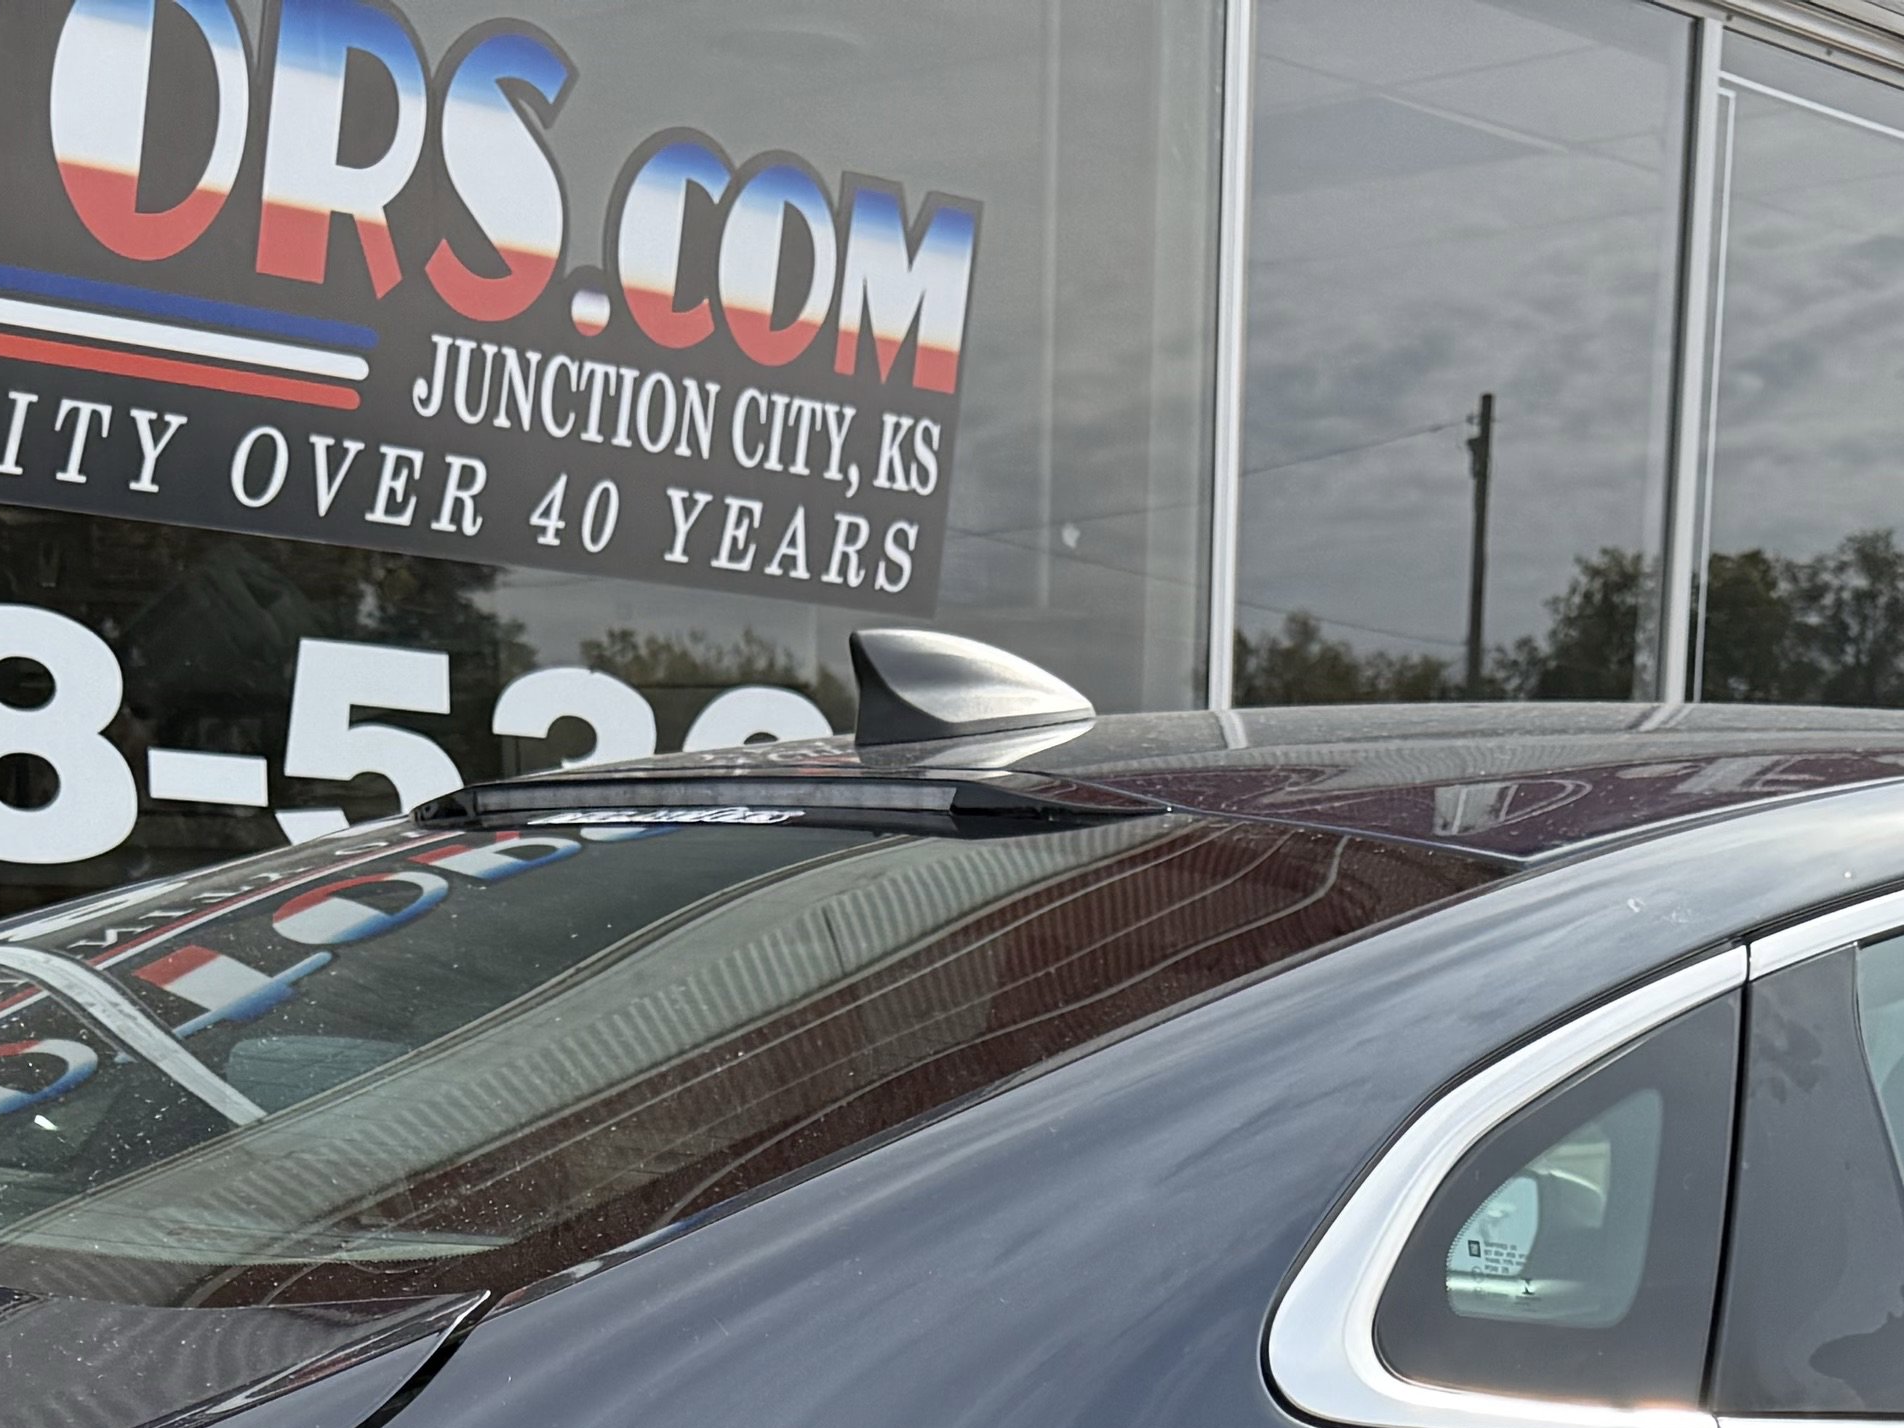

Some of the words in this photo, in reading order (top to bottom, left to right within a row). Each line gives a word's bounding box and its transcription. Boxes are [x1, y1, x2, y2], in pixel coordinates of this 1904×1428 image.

[412, 334, 720, 461] JUNCTION
[731, 387, 860, 498] CITY,
[873, 412, 942, 496] KS
[230, 427, 489, 537] OVER
[529, 472, 620, 553] 40
[664, 487, 919, 594] YEARS
